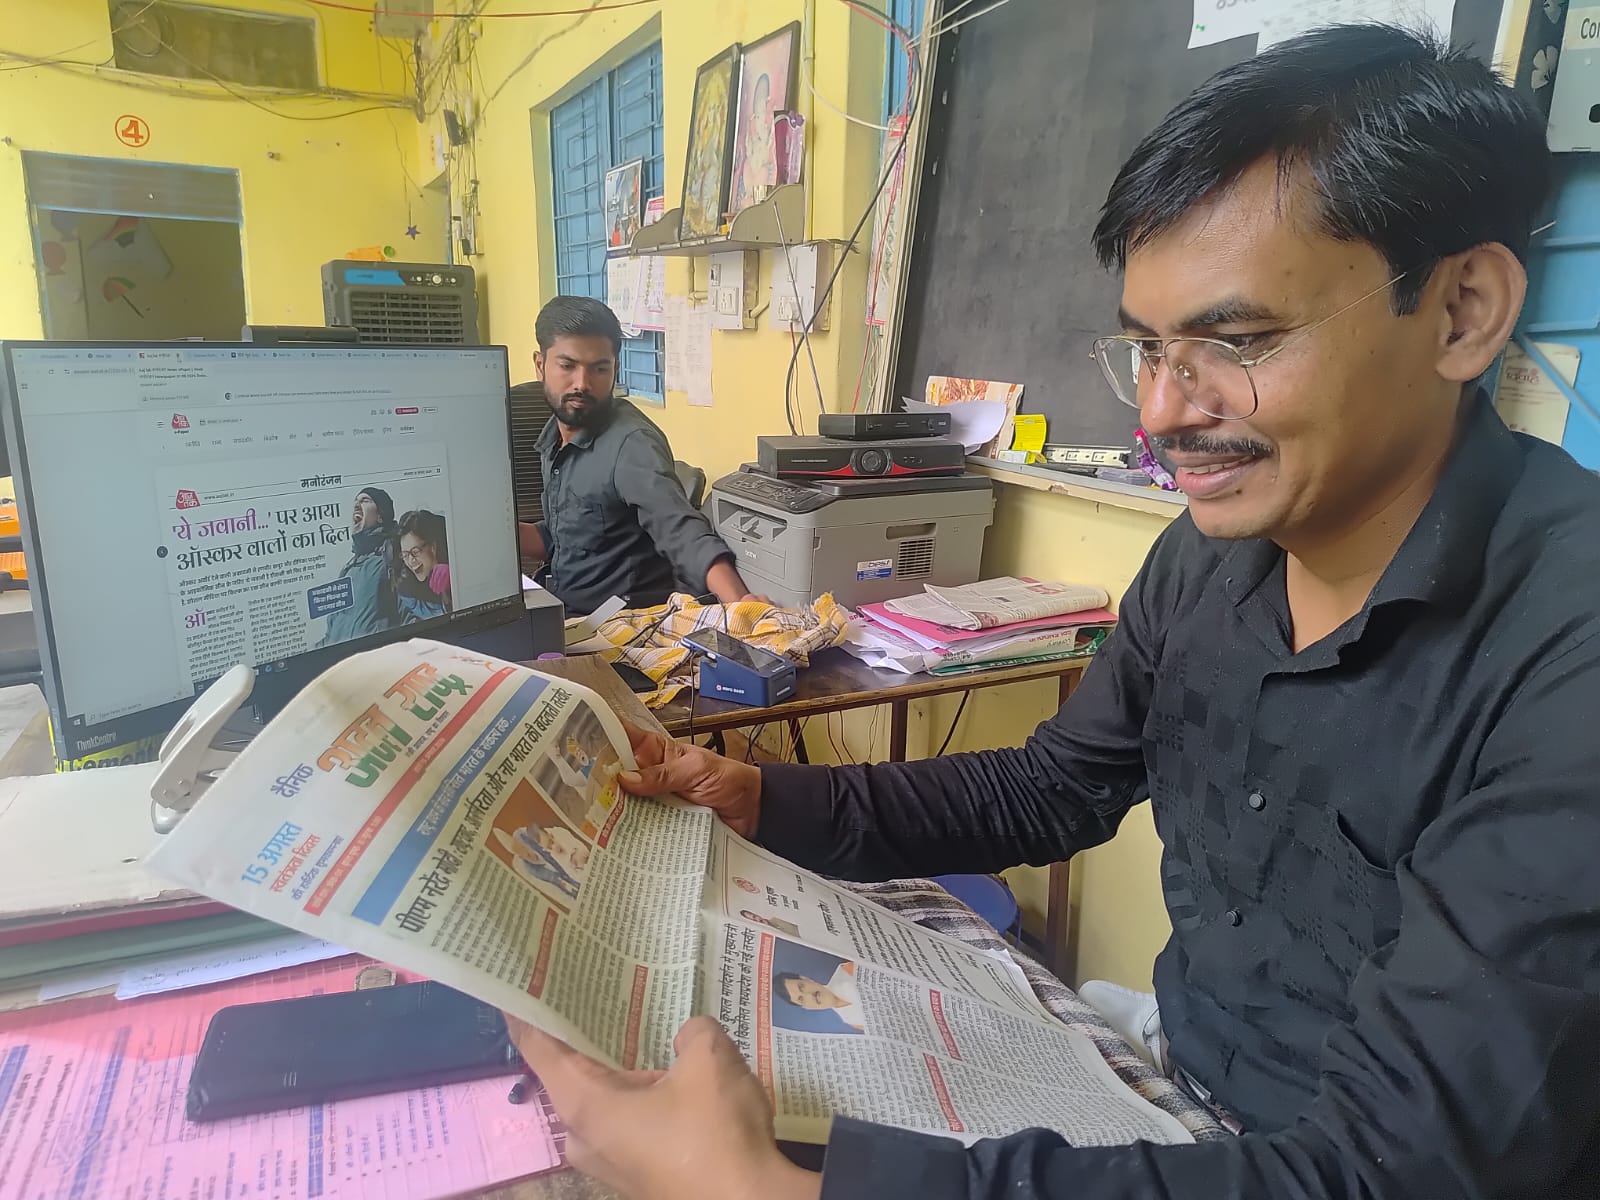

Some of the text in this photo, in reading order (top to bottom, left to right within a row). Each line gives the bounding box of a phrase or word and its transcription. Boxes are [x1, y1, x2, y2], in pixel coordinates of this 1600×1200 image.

[122, 119, 144, 143] 4
[300, 474, 342, 489] मनोरंजन
[178, 492, 194, 503] आज
[184, 499, 199, 508] तक
[275, 509, 298, 526] पर
[302, 502, 341, 519] आया
[177, 523, 351, 571] ऑस्कर वालों का दिल
[532, 699, 560, 734] बदलती
[523, 721, 542, 746] की
[459, 754, 481, 777] भारत
[471, 745, 486, 761] के
[480, 727, 502, 752] संकल्प
[510, 737, 532, 763] भारत
[271, 761, 315, 798] दैनिक
[498, 757, 517, 777] नए
[485, 772, 507, 796] और
[241, 820, 304, 885] 15 अगस्त
[270, 833, 322, 893] स्वतंत्रता दिवस
[291, 887, 305, 901] की
[300, 866, 320, 890] हार्दिक
[395, 895, 435, 934] पीएम
[741, 927, 757, 951] तस्वीर
[737, 962, 753, 975] की
[739, 950, 755, 963] नई
[735, 974, 753, 1007] मध्यप्रदेश
[719, 997, 737, 1025] कुशल
[733, 1006, 752, 1040] विकसित
